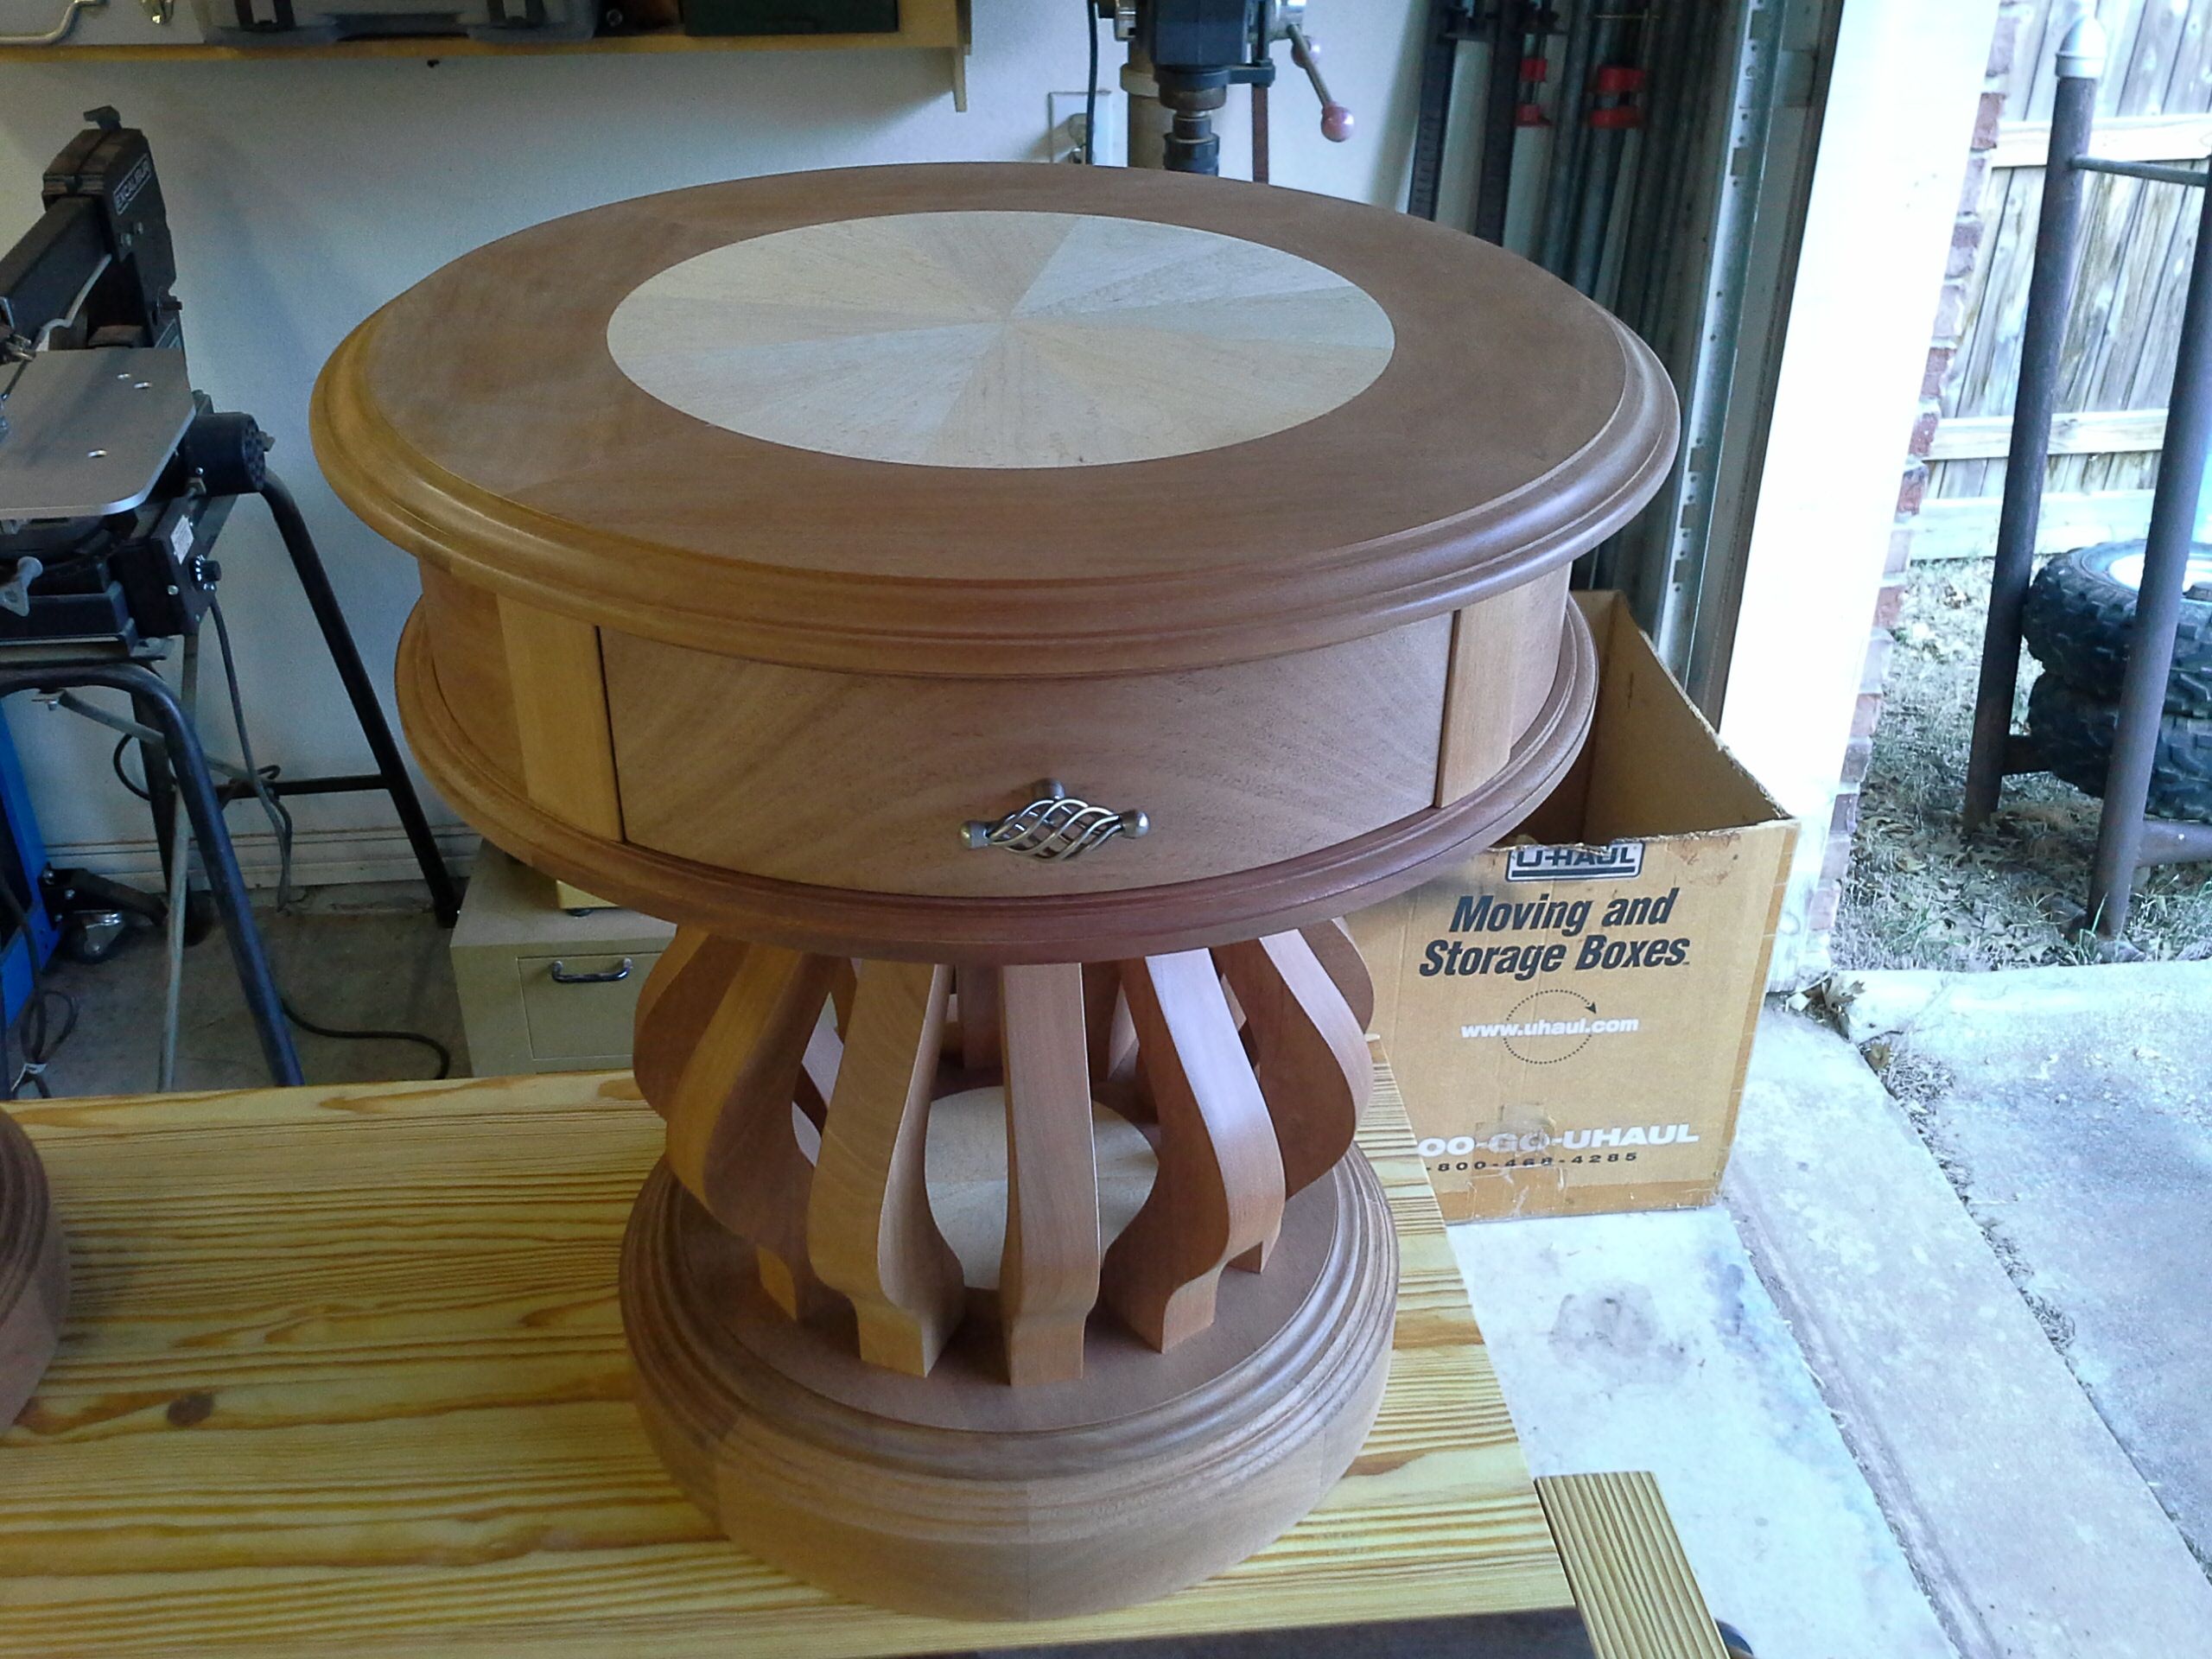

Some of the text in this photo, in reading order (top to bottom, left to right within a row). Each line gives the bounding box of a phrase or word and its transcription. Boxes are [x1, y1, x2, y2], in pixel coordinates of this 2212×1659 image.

[1516, 846, 1635, 867] U-HAUL
[1449, 887, 1680, 937] Moving and
[1420, 935, 1690, 981] Storage Boxes
[1461, 1018, 1639, 1038] www.uhaul.com
